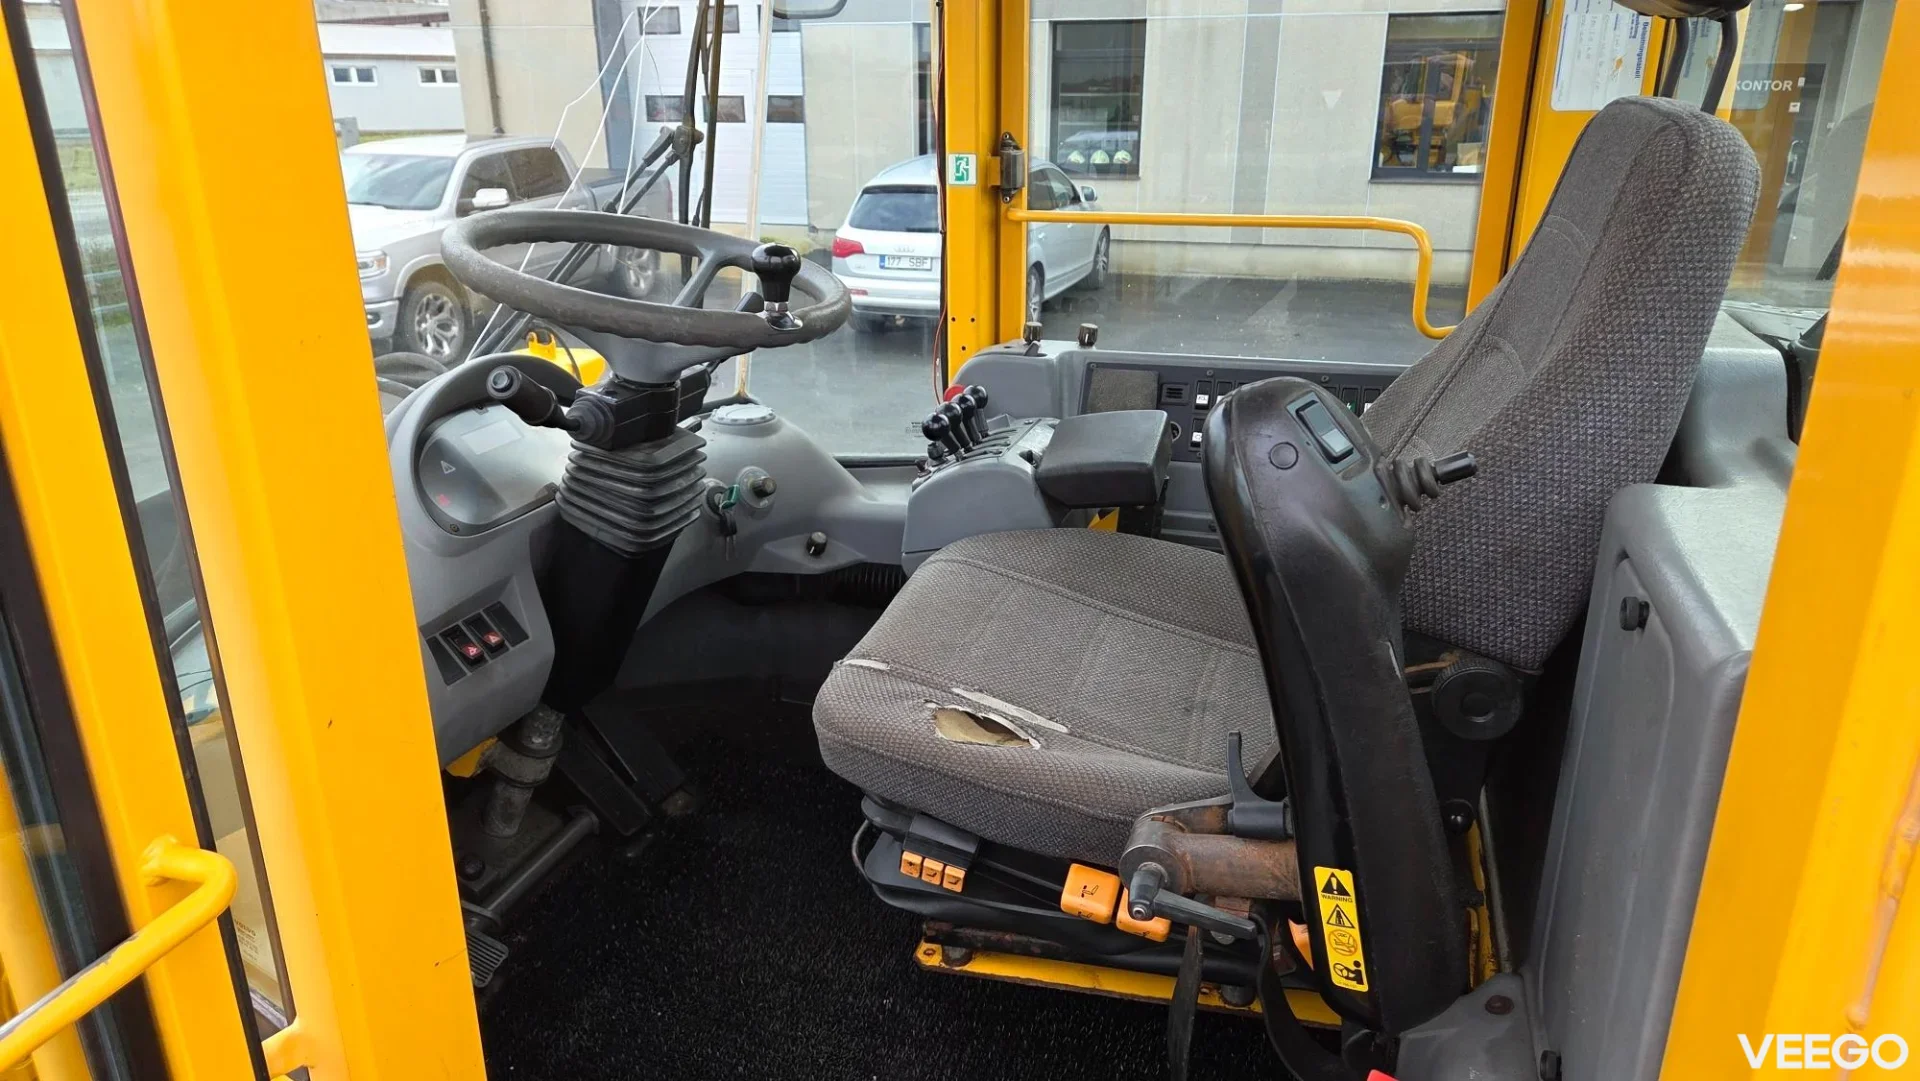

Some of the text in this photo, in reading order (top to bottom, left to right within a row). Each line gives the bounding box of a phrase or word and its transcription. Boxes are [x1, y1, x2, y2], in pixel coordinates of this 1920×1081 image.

[887, 256, 929, 268] 177 SBF
[1320, 893, 1353, 903] WARNING
